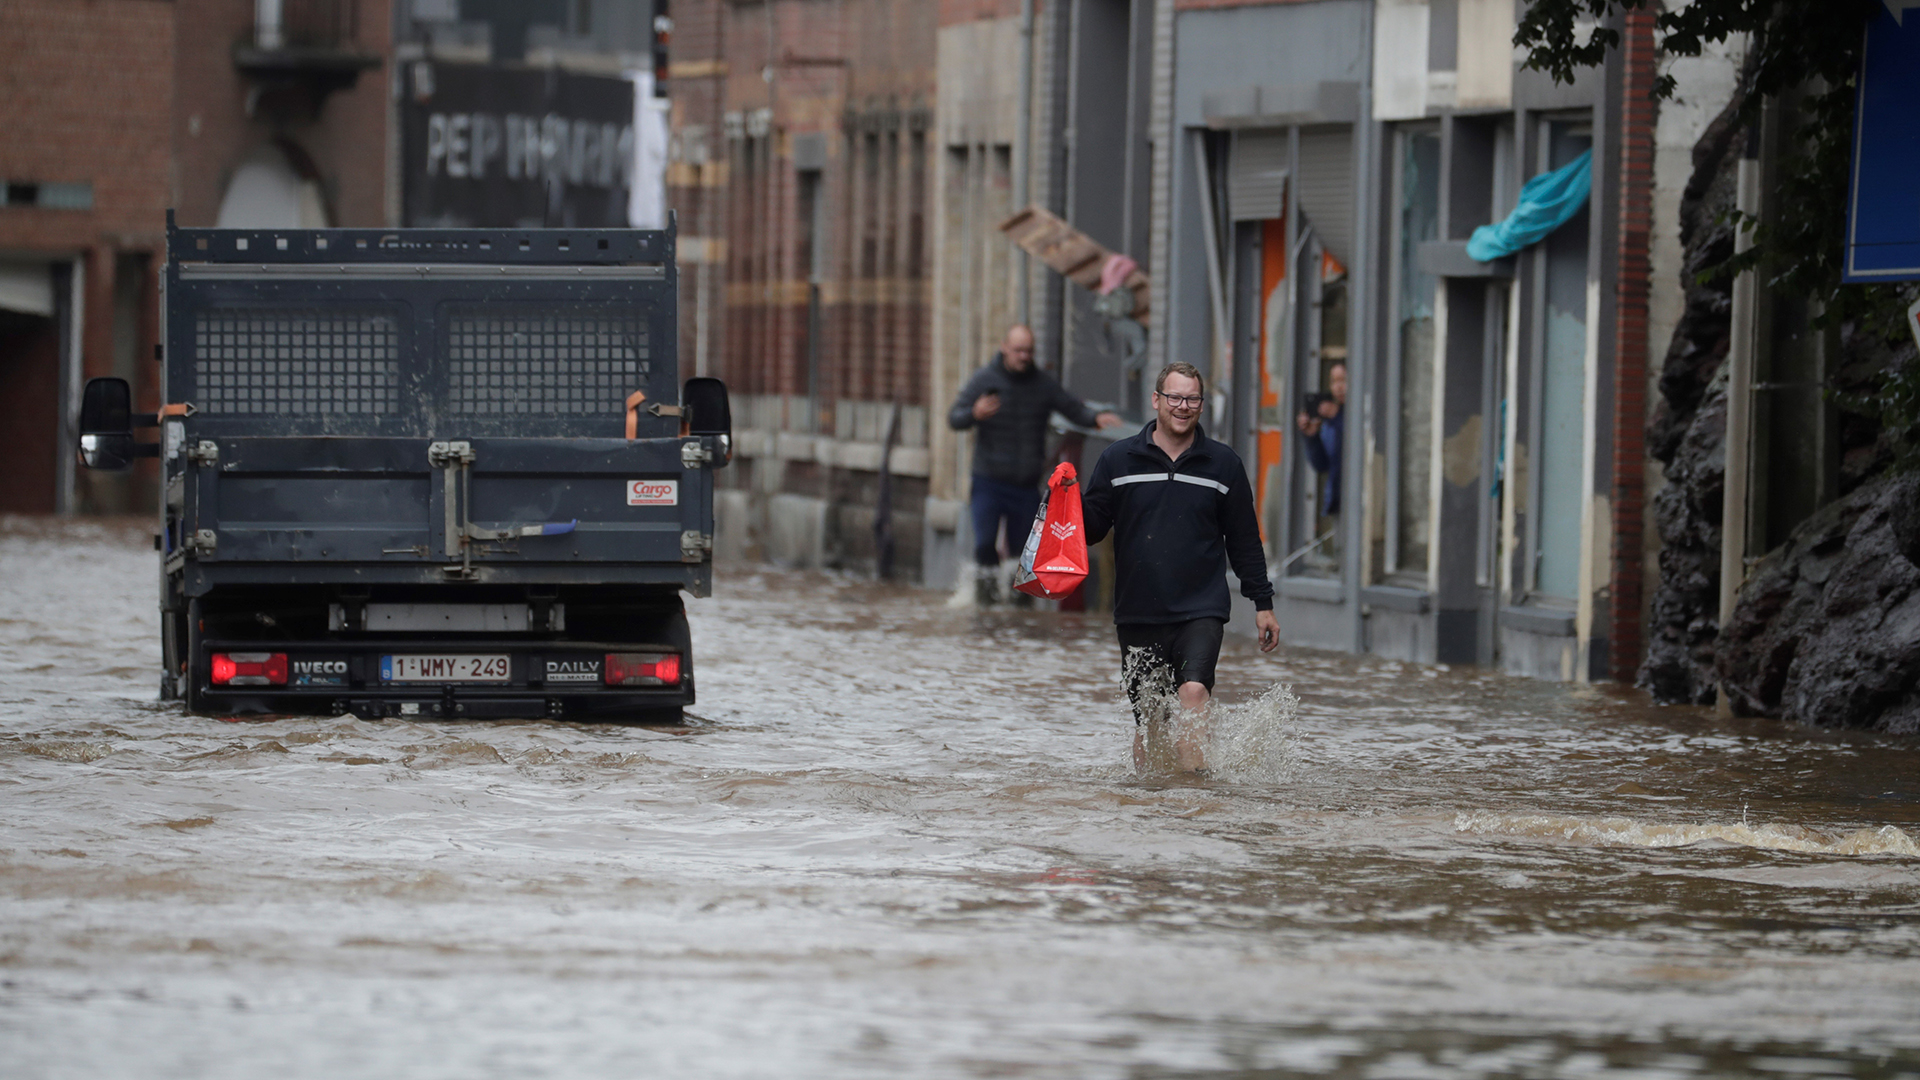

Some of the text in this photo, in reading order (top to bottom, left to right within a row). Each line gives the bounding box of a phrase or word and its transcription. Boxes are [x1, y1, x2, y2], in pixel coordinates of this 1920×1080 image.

[633, 481, 672, 498] Cargo
[293, 661, 348, 674] IVECO
[396, 658, 508, 677] 1-WMY-249
[546, 661, 600, 672] DAILY
[383, 669, 391, 679] B
